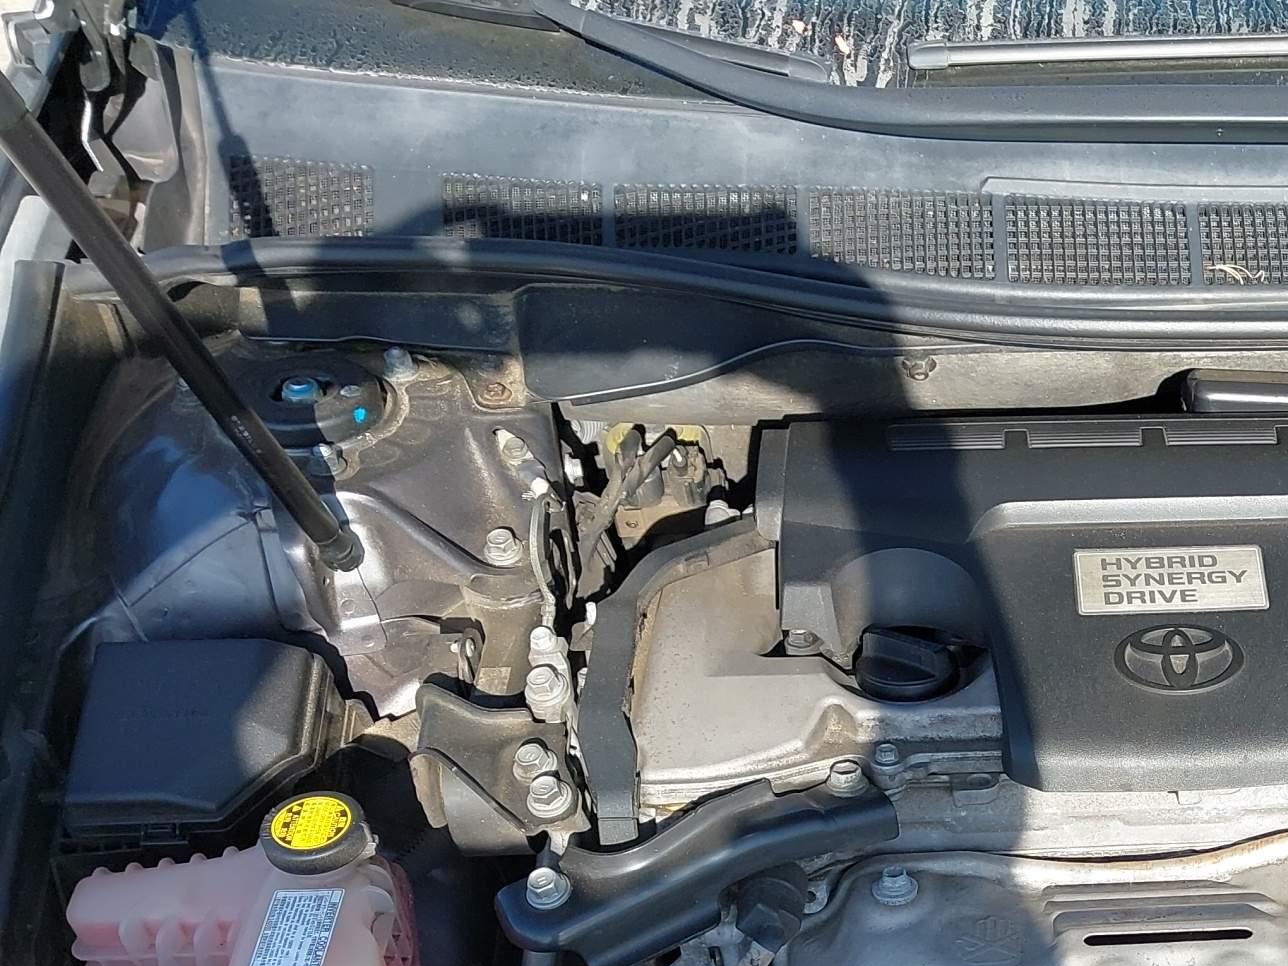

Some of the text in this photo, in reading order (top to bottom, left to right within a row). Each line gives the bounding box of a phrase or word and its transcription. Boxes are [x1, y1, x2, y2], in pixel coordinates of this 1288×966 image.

[1100, 554, 1218, 570] HYBRID
[1101, 570, 1248, 588] SYNERGY
[1103, 588, 1198, 606] DRIVE
[311, 902, 338, 966] INVERTER COOLANT
